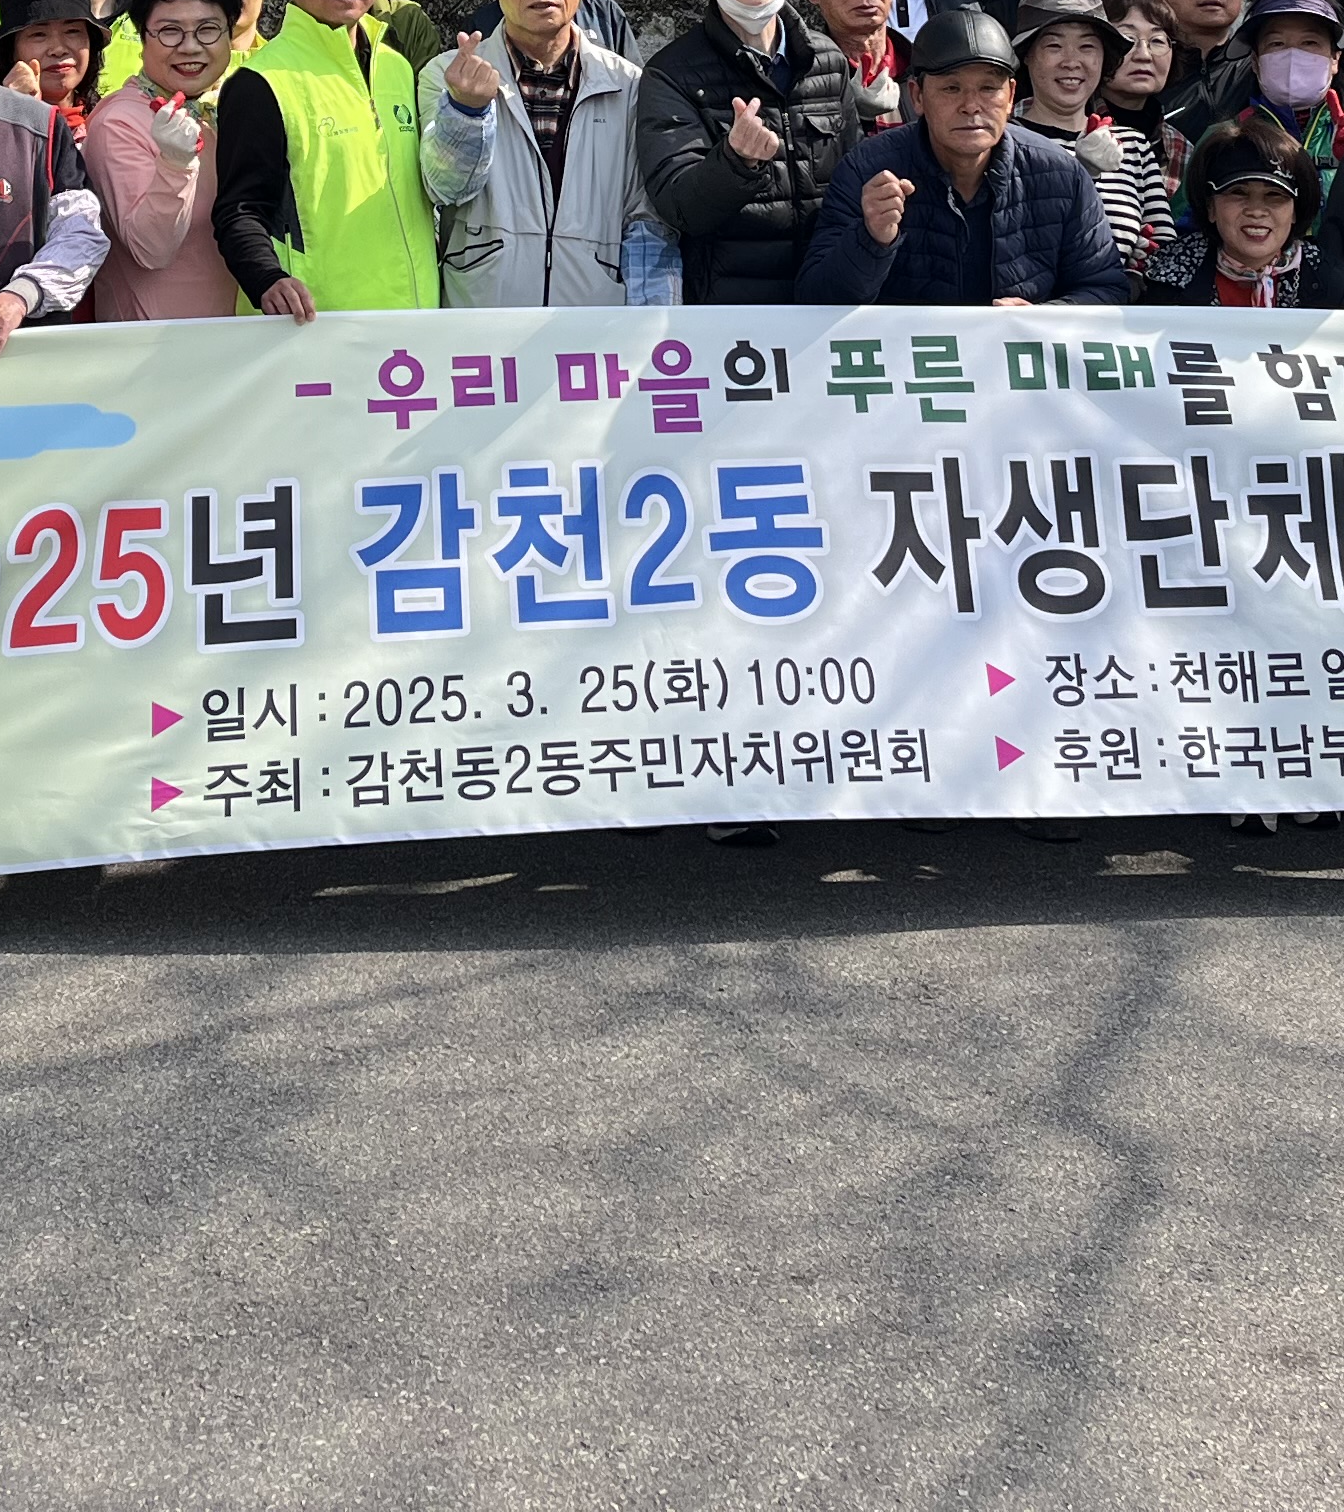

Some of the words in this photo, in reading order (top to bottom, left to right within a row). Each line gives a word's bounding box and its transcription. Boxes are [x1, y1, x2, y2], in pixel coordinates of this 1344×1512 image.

[367, 349, 518, 430] 우리
[554, 339, 790, 434] 마을의
[826, 335, 975, 423] 푸른
[1003, 340, 1236, 426] 미래를
[356, 463, 823, 634] 감천2동
[202, 683, 298, 743] 일시
[343, 674, 482, 729] 2025.
[579, 658, 729, 713] 25(화)
[748, 657, 875, 706] 10:00
[1045, 653, 1138, 707] 장소
[203, 757, 301, 818] 주최
[345, 728, 931, 808] 감천동2동주민자치위원회
[1054, 727, 1142, 783] 후원
